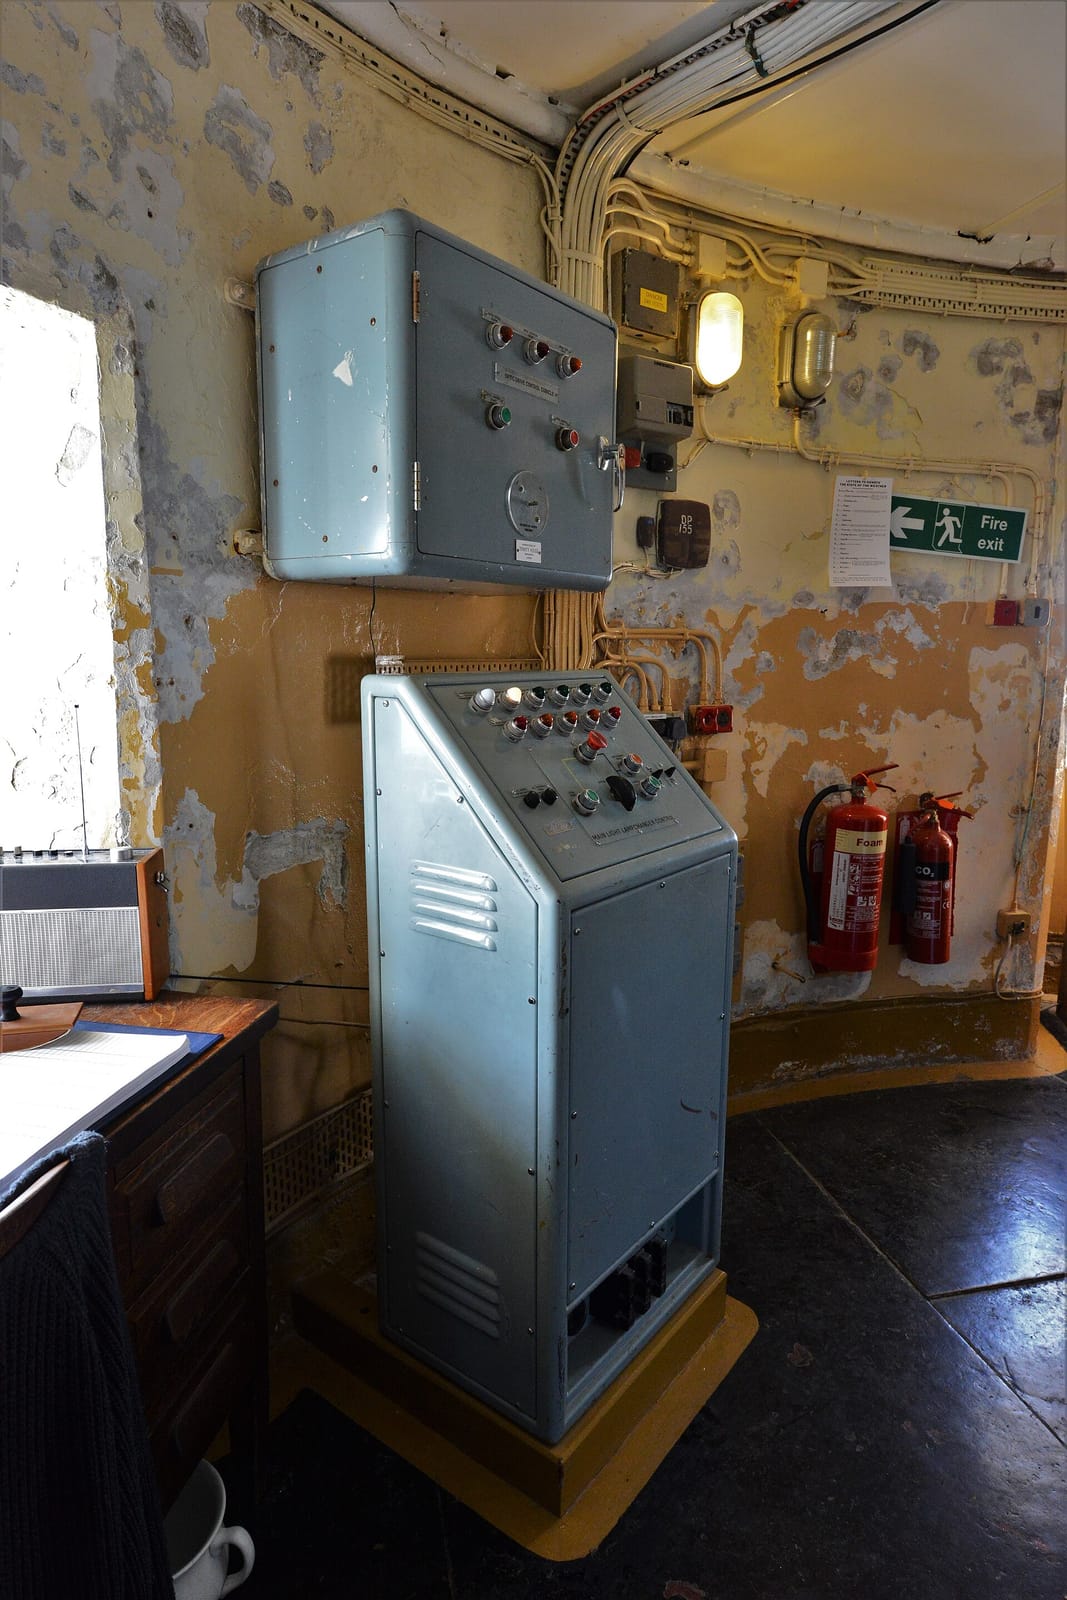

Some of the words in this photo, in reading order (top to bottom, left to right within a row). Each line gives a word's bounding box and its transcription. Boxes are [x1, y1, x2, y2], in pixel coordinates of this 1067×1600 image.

[679, 523, 693, 535] 155
[981, 515, 1008, 531] Fire
[977, 537, 1005, 551] exit
[591, 832, 606, 840] MAIN
[606, 828, 620, 837] LIGHT
